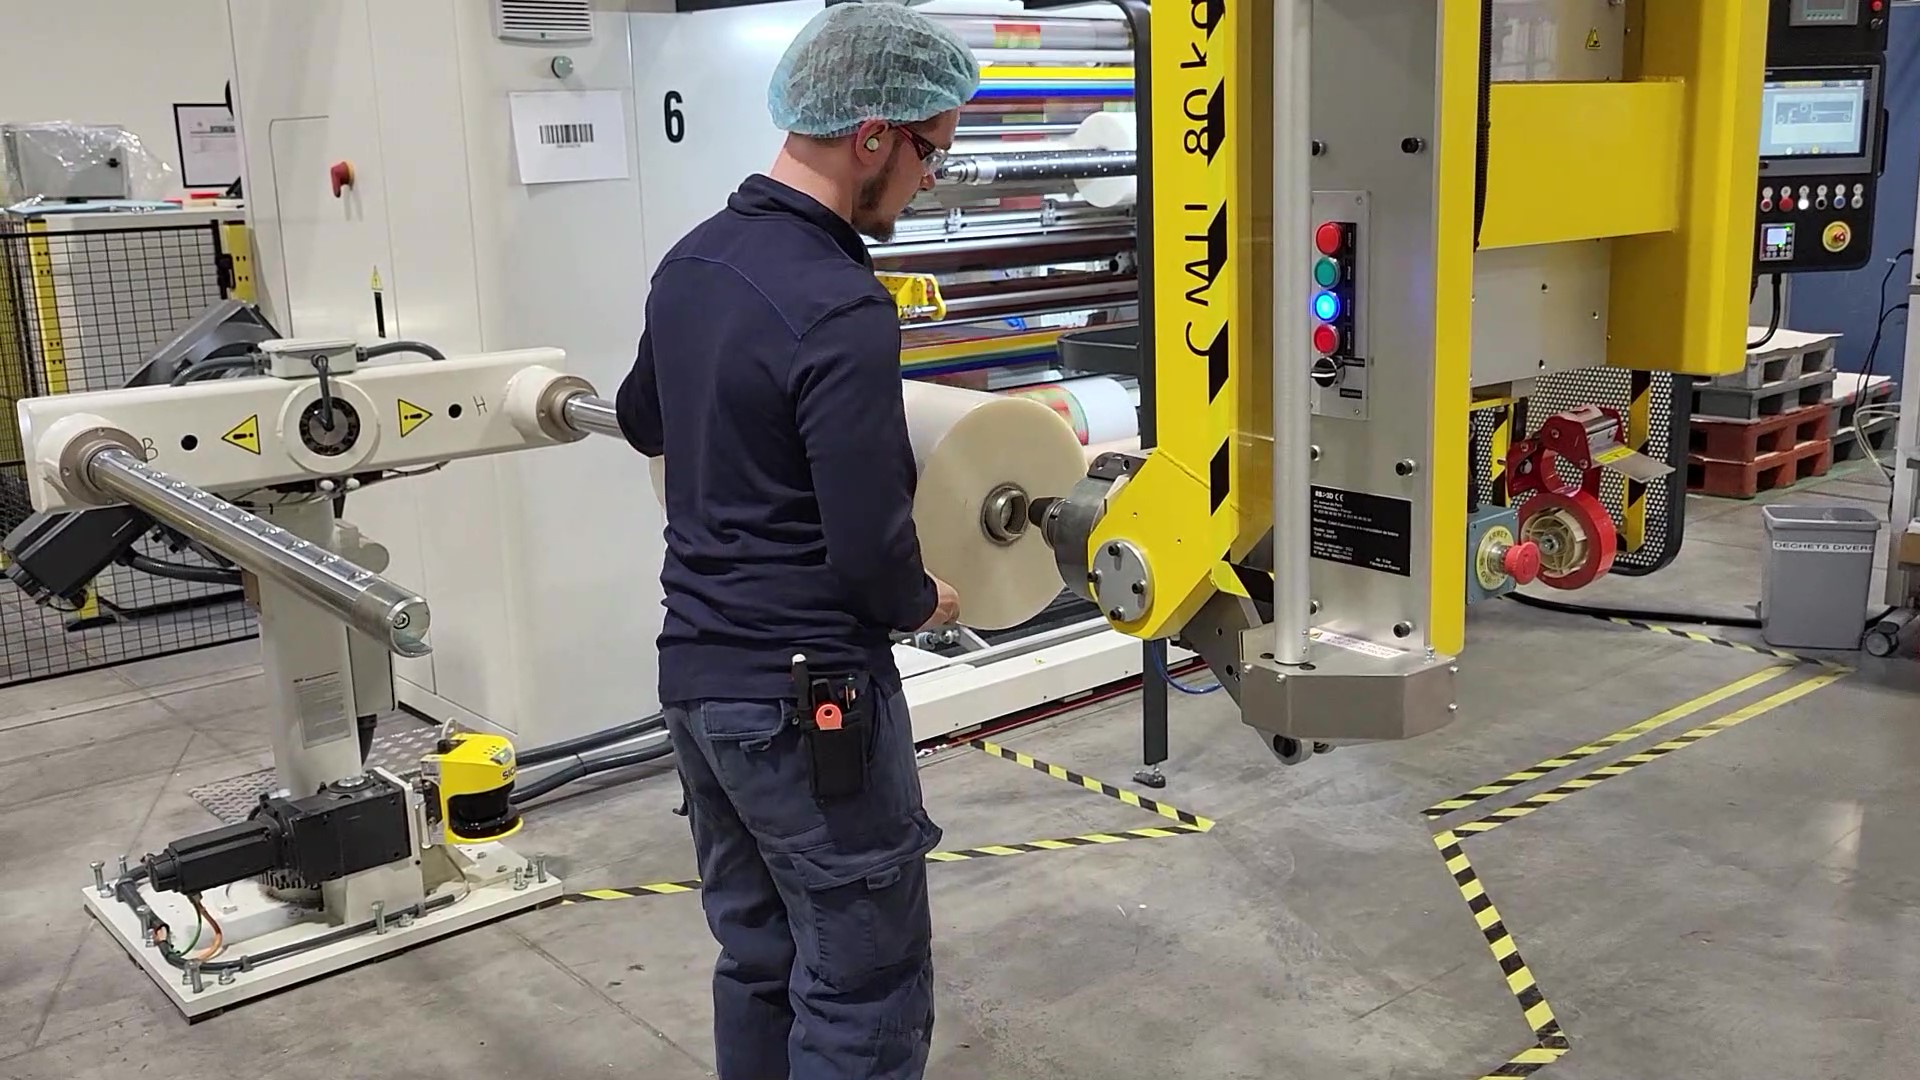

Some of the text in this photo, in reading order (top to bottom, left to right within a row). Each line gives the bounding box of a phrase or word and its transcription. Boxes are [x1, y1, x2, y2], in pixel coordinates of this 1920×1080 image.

[663, 90, 686, 144] 6
[472, 395, 488, 416] H
[142, 437, 159, 461] B
[1774, 542, 1830, 550] DECHETS
[502, 766, 516, 781] SIC
